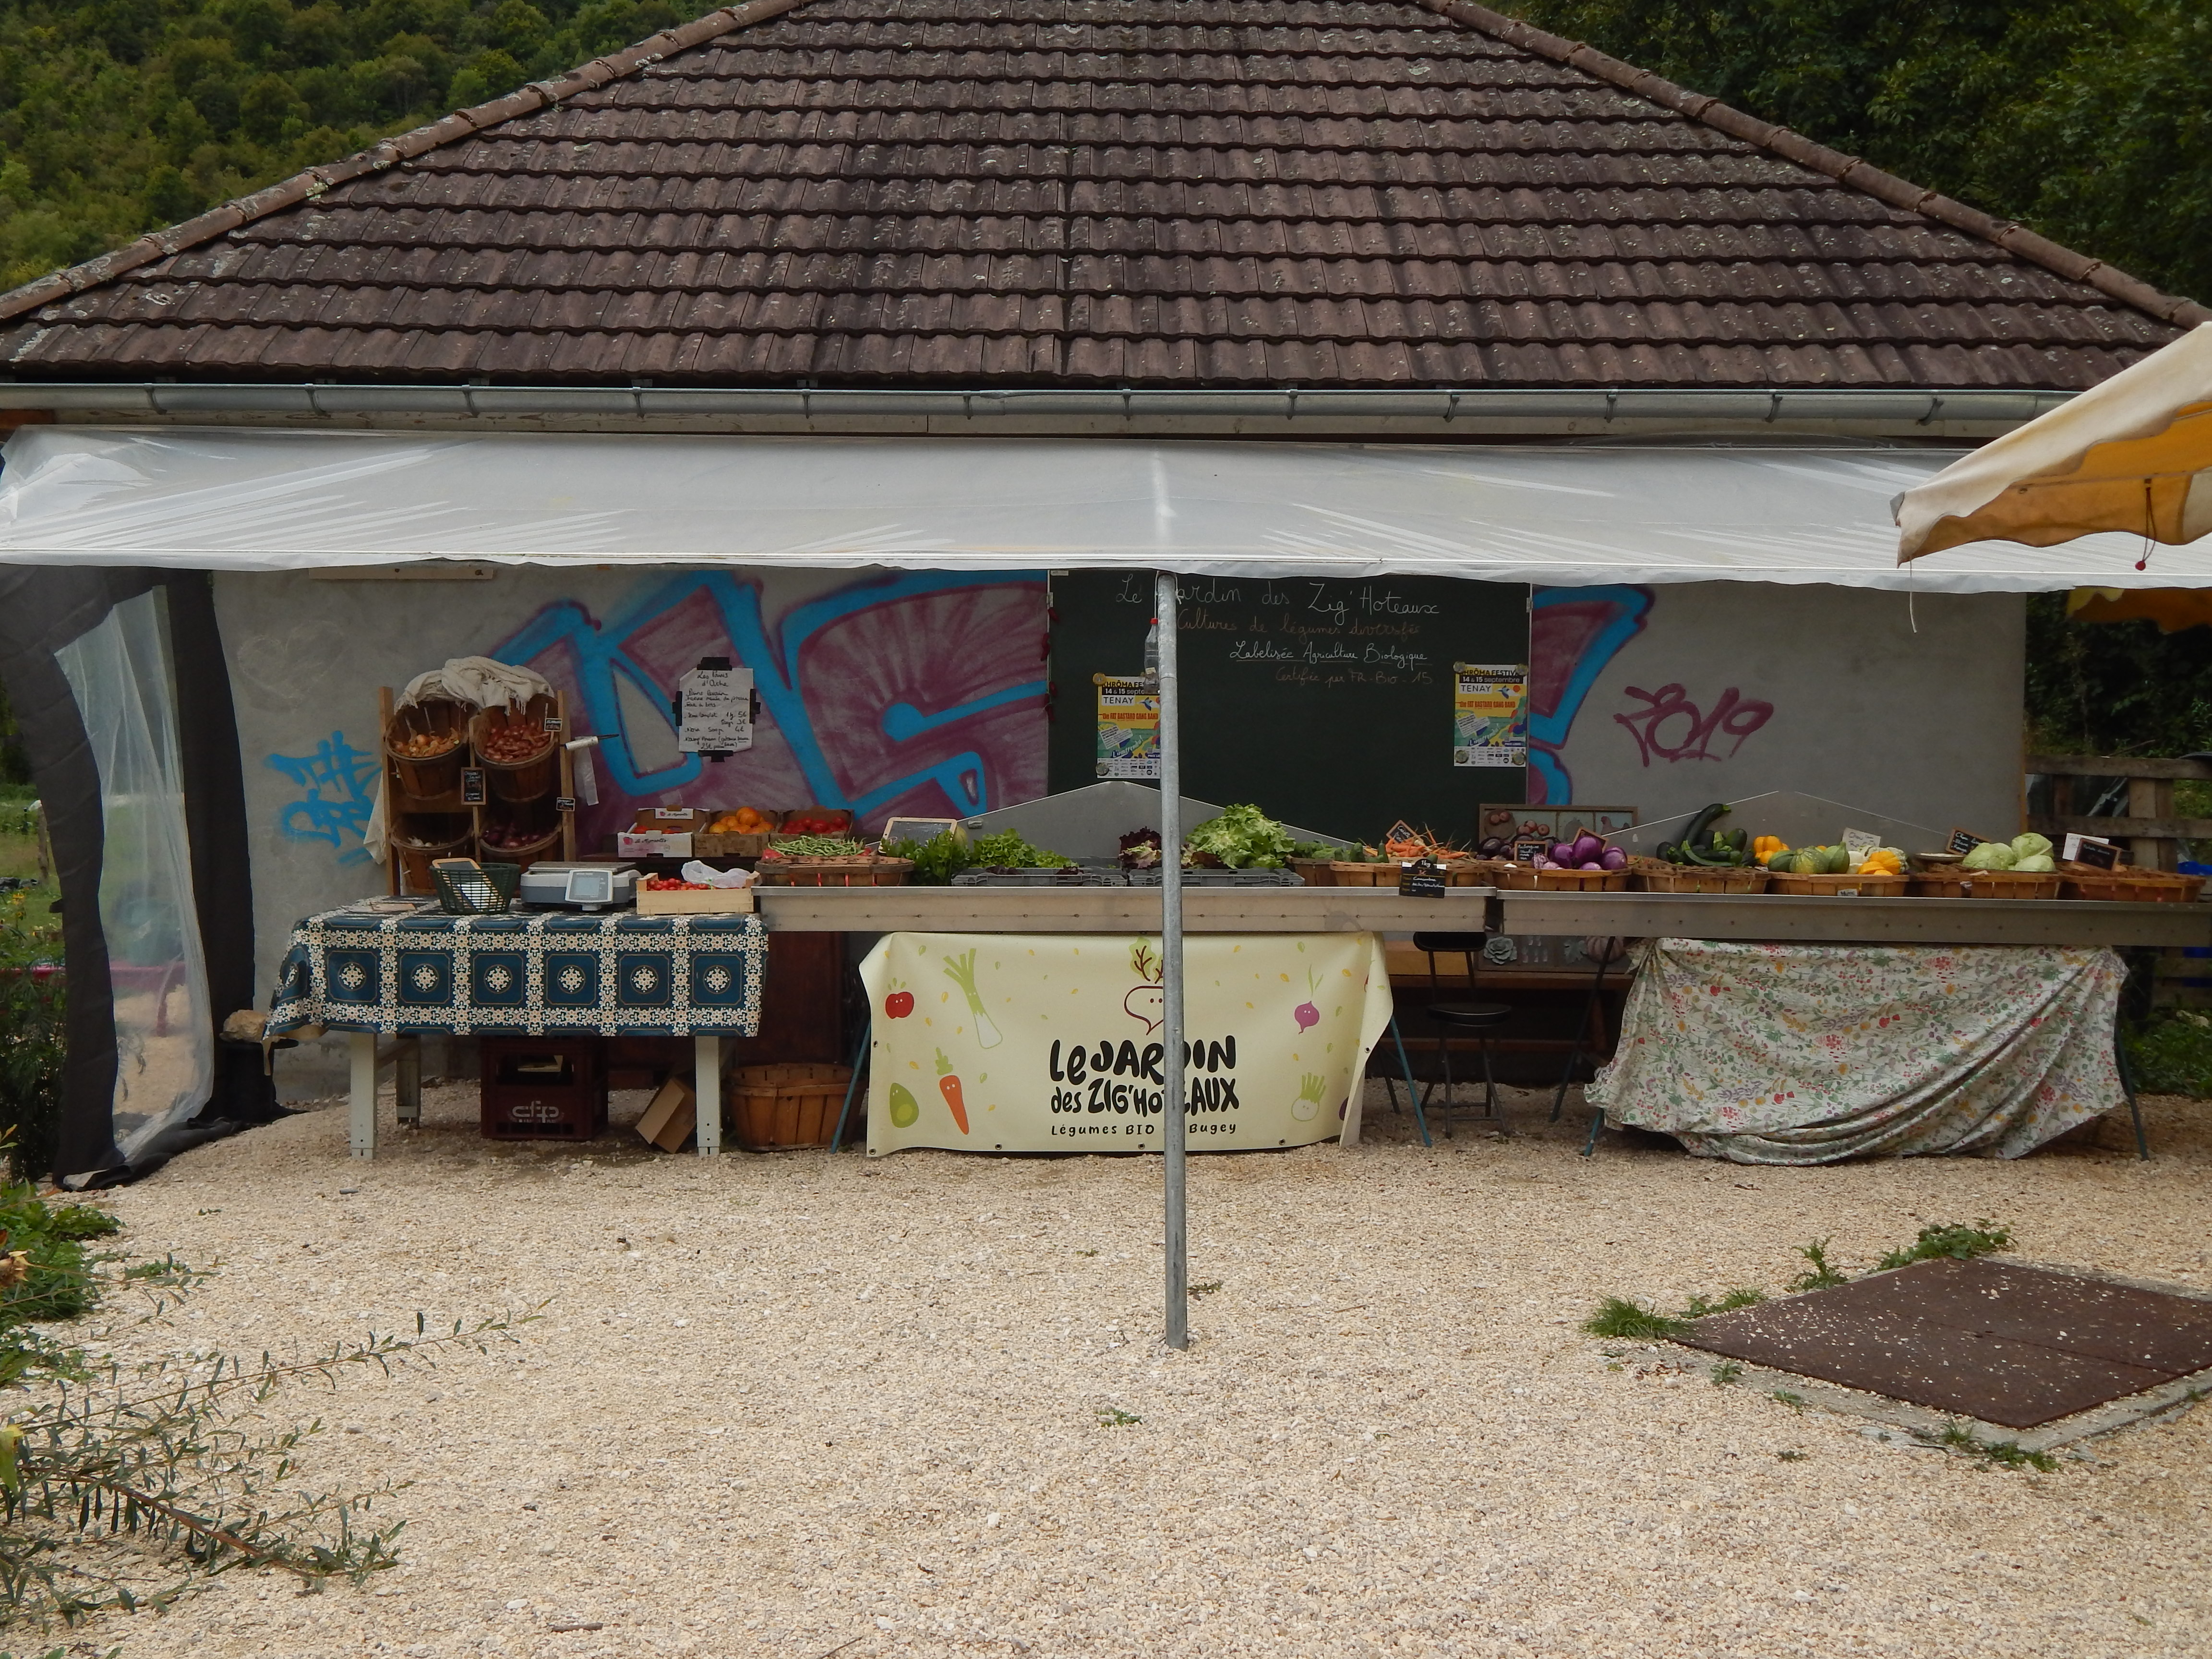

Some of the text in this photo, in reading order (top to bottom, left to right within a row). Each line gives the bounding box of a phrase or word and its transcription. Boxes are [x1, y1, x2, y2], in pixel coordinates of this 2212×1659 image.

[1116, 574, 1142, 603] Le
[1262, 581, 1289, 605] des
[1177, 607, 1237, 630] Cultures
[1250, 615, 1268, 633] de
[1229, 640, 1428, 671] Labelisée Agriculture Biologique
[1050, 1039, 1086, 1085] Le
[1051, 1077, 1239, 1118] des ZIG'HOAUX
[1051, 1123, 1236, 1137] Légumes BIO Bugey
